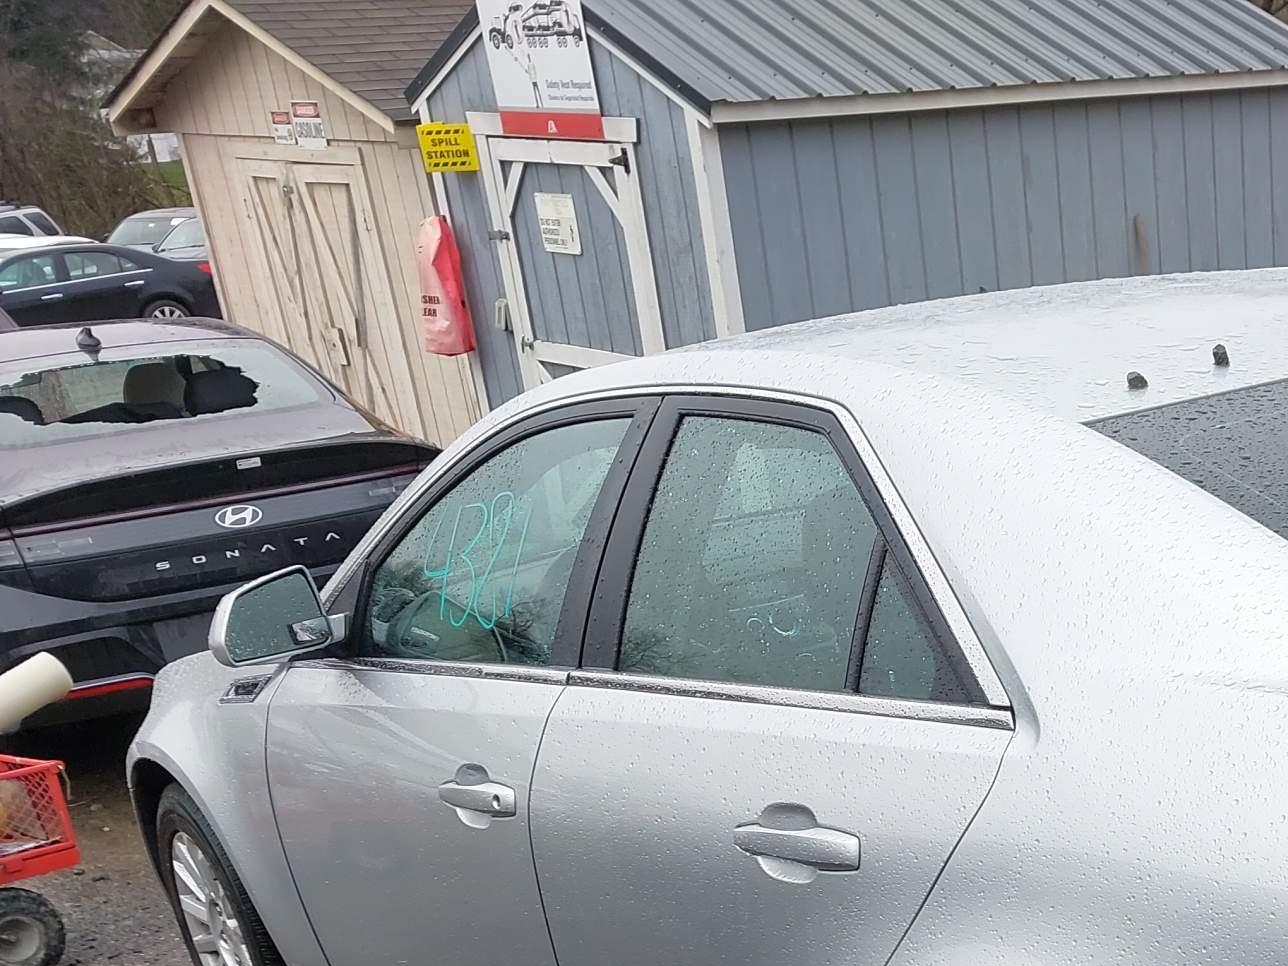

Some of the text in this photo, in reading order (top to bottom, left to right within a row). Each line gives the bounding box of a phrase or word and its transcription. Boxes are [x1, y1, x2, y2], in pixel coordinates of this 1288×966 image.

[430, 137, 460, 147] SPILL
[426, 149, 470, 160] STATION
[155, 532, 341, 571] SONATA
